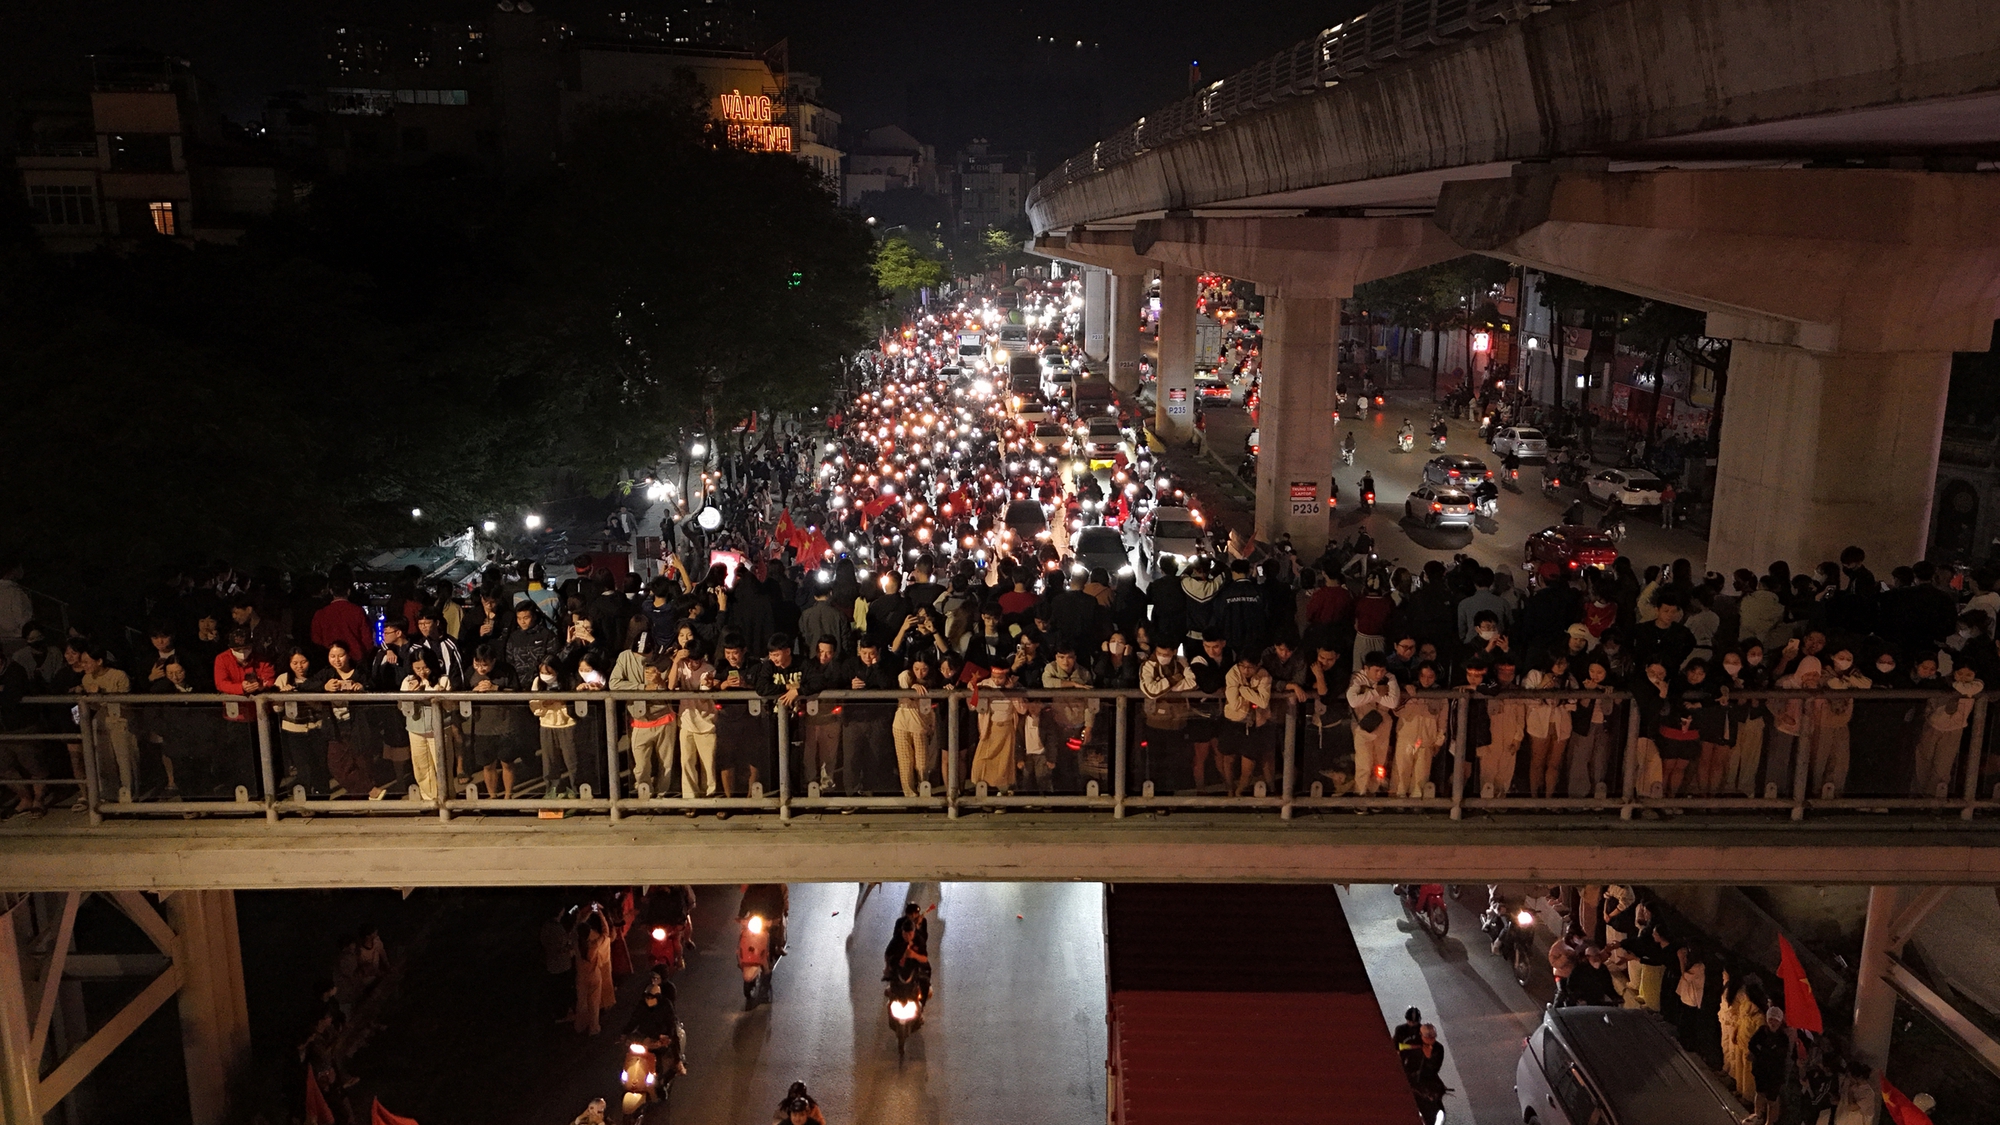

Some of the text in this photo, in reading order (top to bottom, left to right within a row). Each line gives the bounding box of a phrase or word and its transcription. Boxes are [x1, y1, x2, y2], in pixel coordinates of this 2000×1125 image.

[720, 89, 771, 120] VÀNG
[1168, 406, 1186, 414] P235
[1292, 503, 1320, 514] P236
